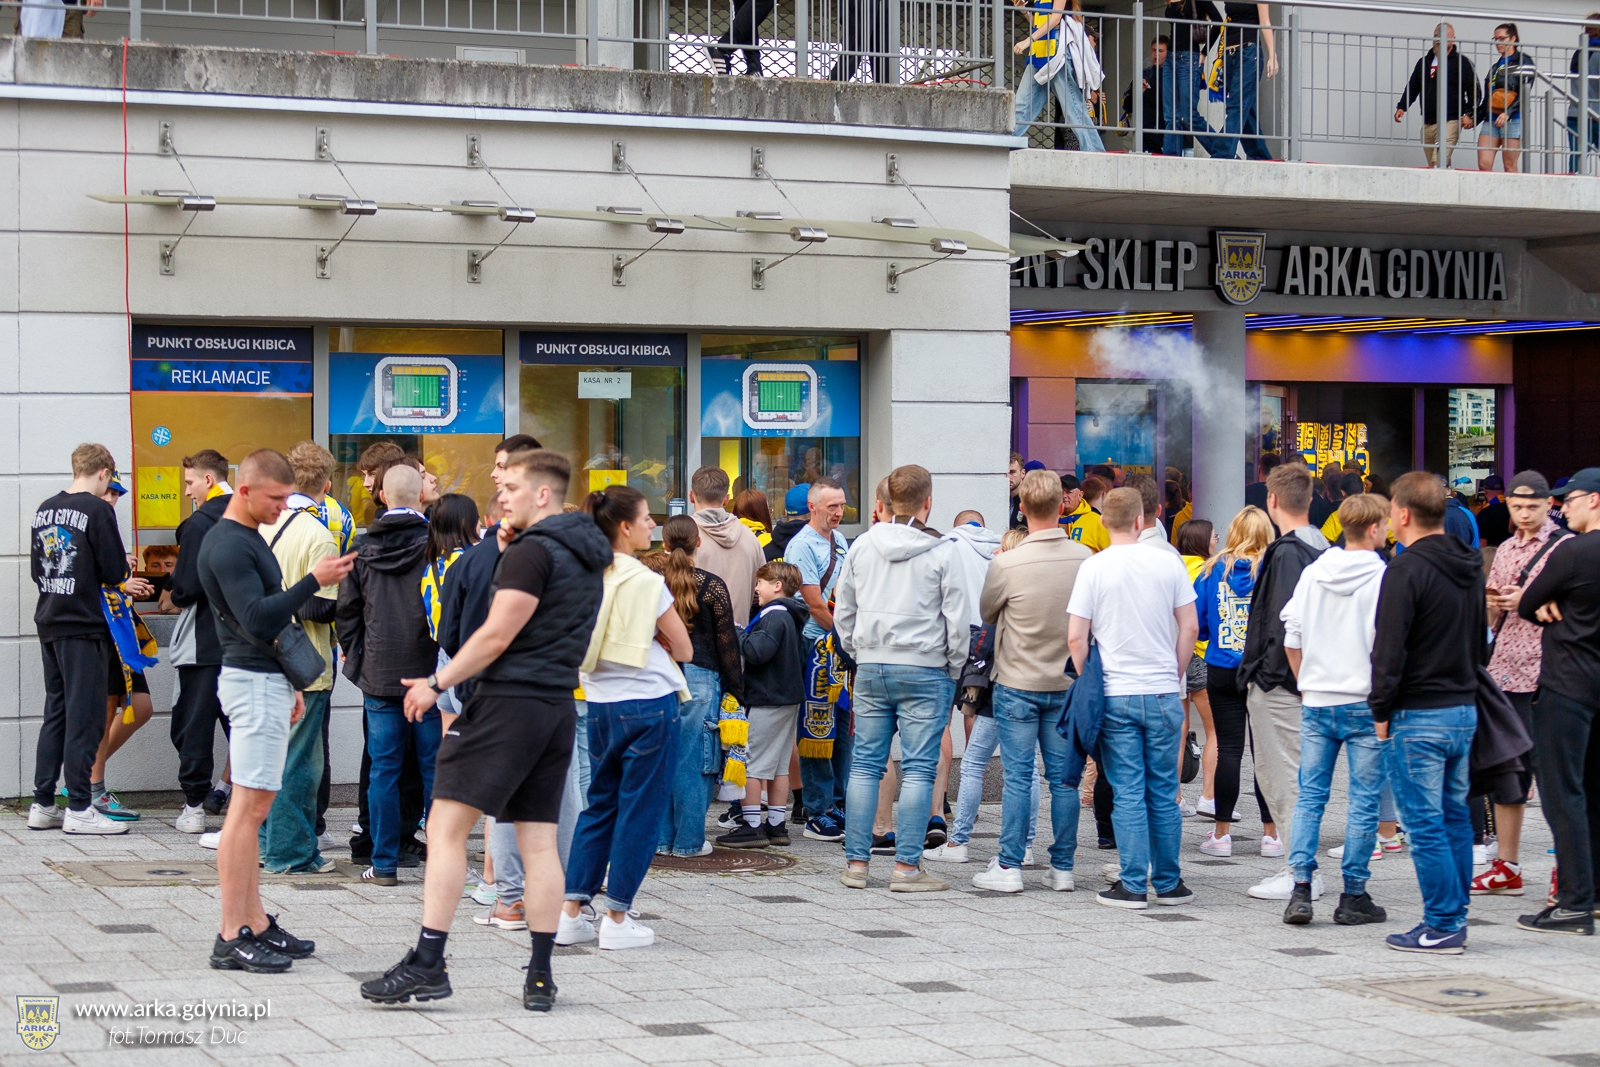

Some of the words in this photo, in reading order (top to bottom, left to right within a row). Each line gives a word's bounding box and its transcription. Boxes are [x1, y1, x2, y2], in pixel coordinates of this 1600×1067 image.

[1083, 238, 1198, 291] SKLEP
[1284, 245, 1376, 297] ARKA
[1387, 248, 1508, 300] GDYNIA
[1225, 271, 1257, 280] ARKA
[147, 336, 192, 349] PUNKT
[194, 337, 250, 350] OBSŁUGI
[252, 338, 296, 351] KIBICA
[536, 343, 577, 354] PUNKT
[578, 344, 629, 356] OBSŁUGI
[631, 344, 671, 356] KIBICA
[171, 369, 271, 385] REKLAMACJE
[31, 509, 54, 529] ARKA
[54, 508, 88, 532] GDYNIA
